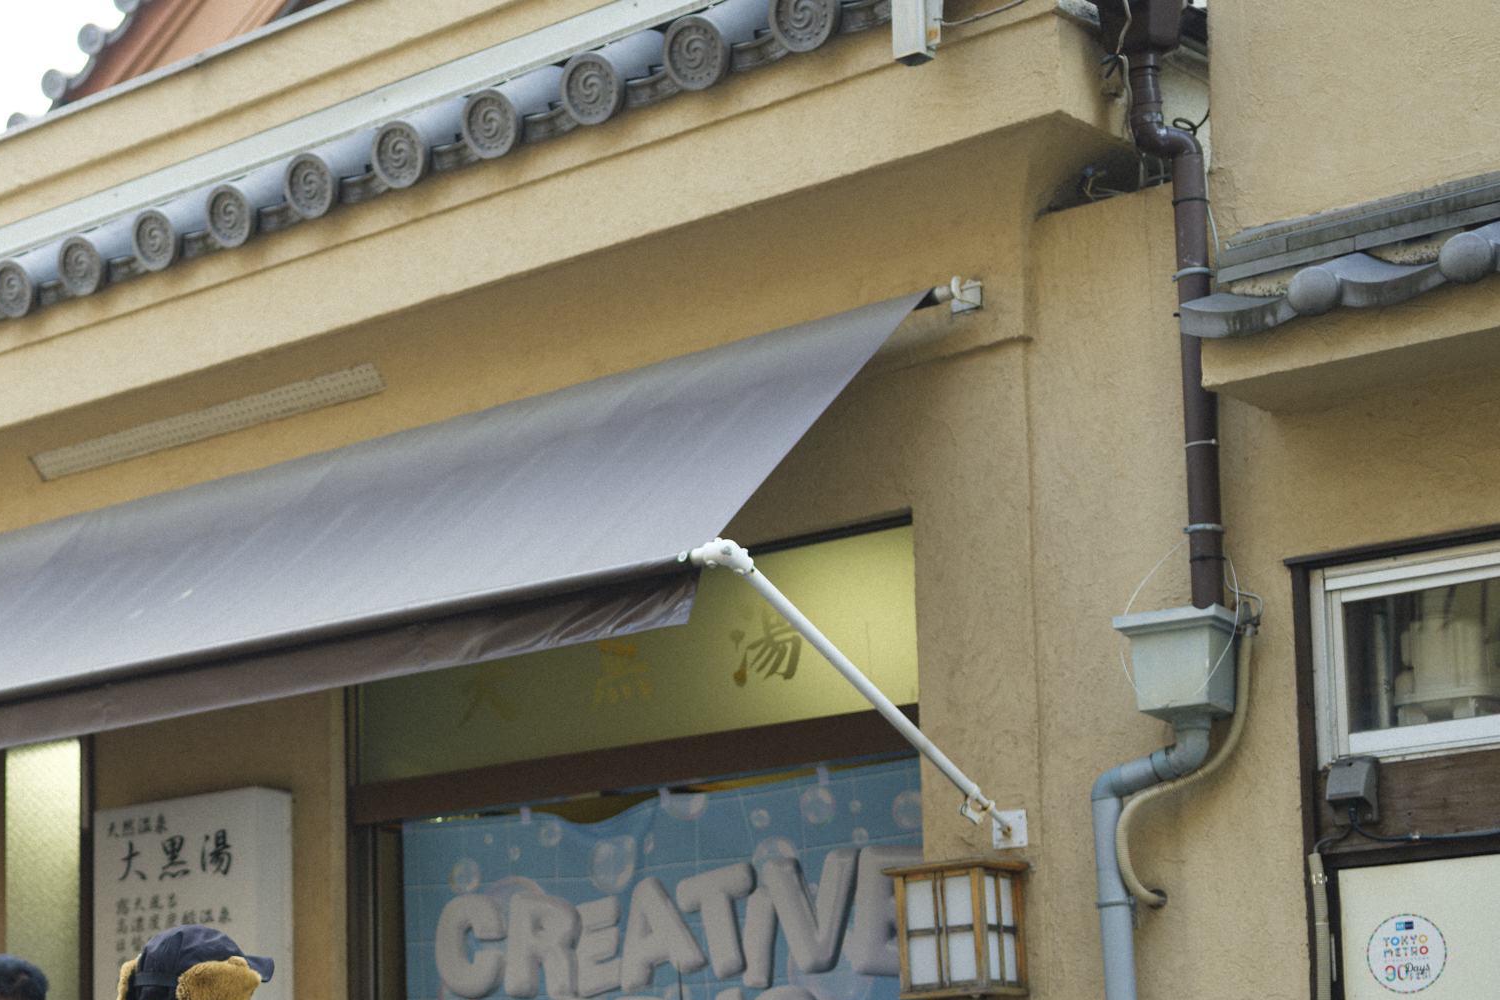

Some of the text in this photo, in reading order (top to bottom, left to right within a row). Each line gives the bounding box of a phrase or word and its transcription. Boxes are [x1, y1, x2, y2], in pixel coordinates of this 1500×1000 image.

[118, 829, 232, 881] 大黒湯
[435, 845, 924, 1000] CREATIVE
[1383, 934, 1428, 947] TOKYO
[1384, 946, 1429, 957] METRO
